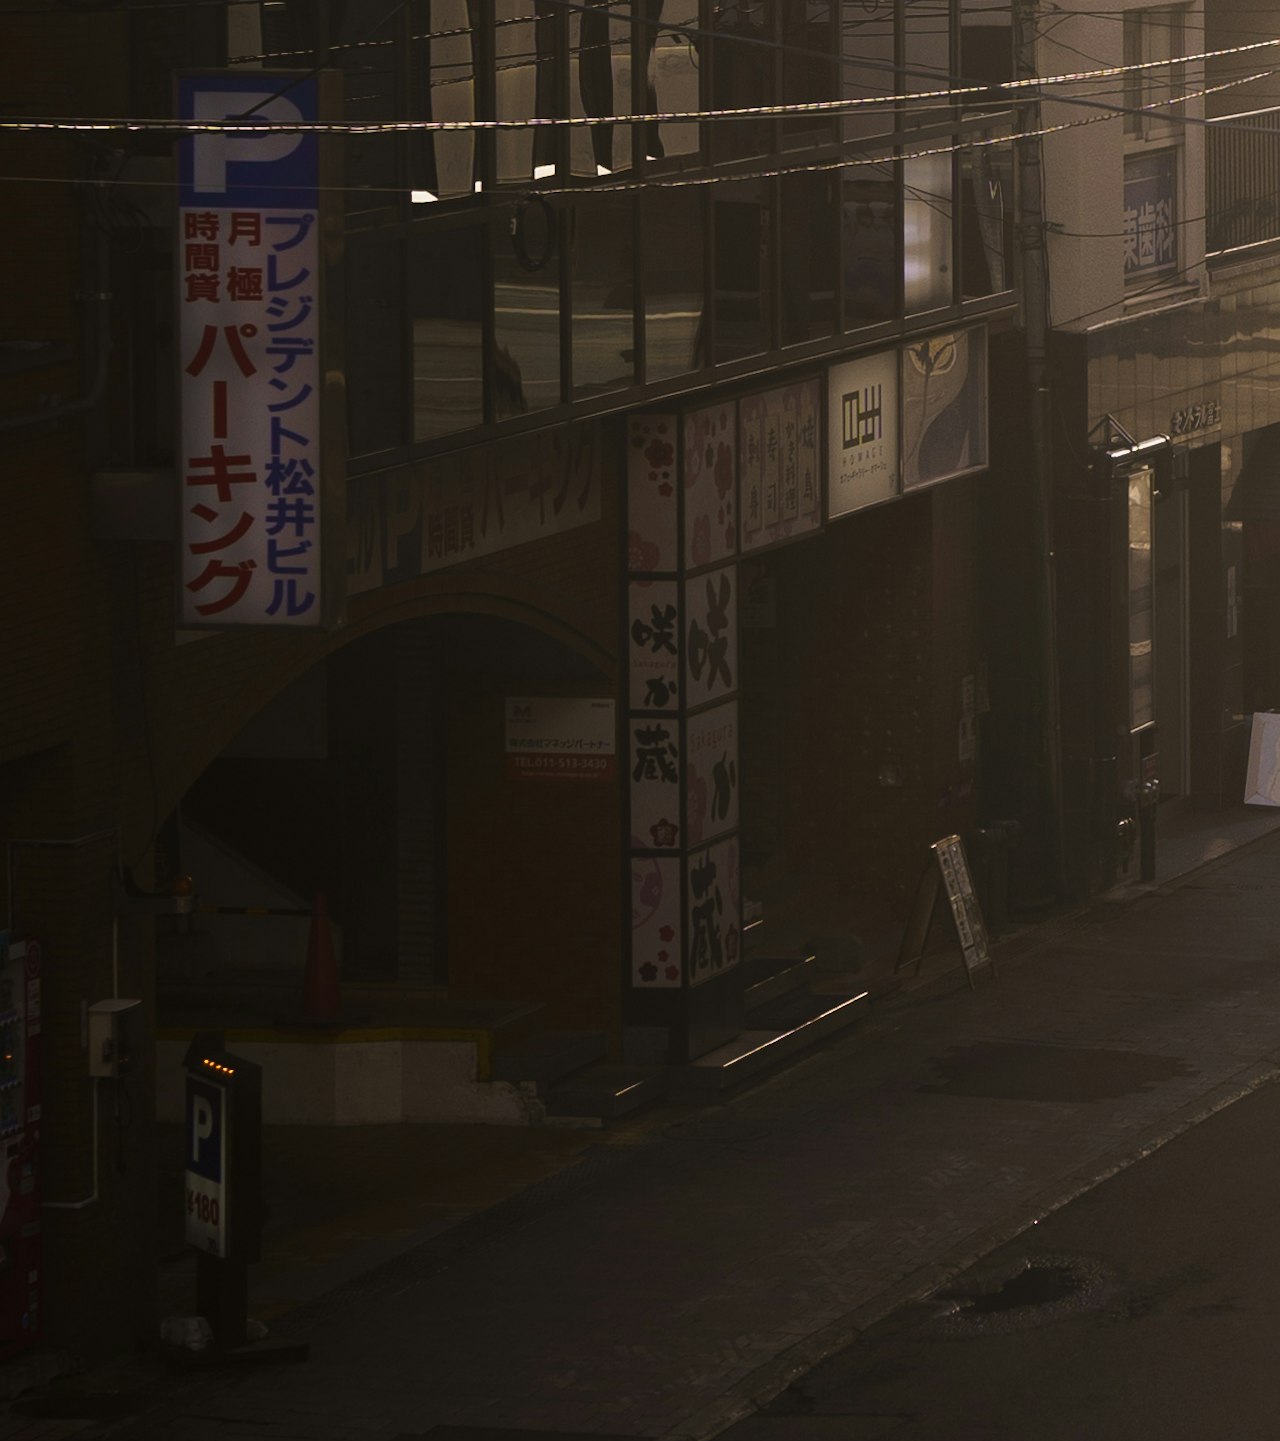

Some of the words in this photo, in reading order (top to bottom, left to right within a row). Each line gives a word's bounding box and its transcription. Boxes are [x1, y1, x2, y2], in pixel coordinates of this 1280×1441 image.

[192, 90, 306, 194] P
[185, 212, 221, 303] 時間貸
[227, 212, 263, 303] 月極
[264, 214, 316, 618] プレジデント松井ビル
[186, 323, 258, 617] パーキング
[192, 1093, 214, 1163] P
[186, 1187, 219, 1227] ¥180
